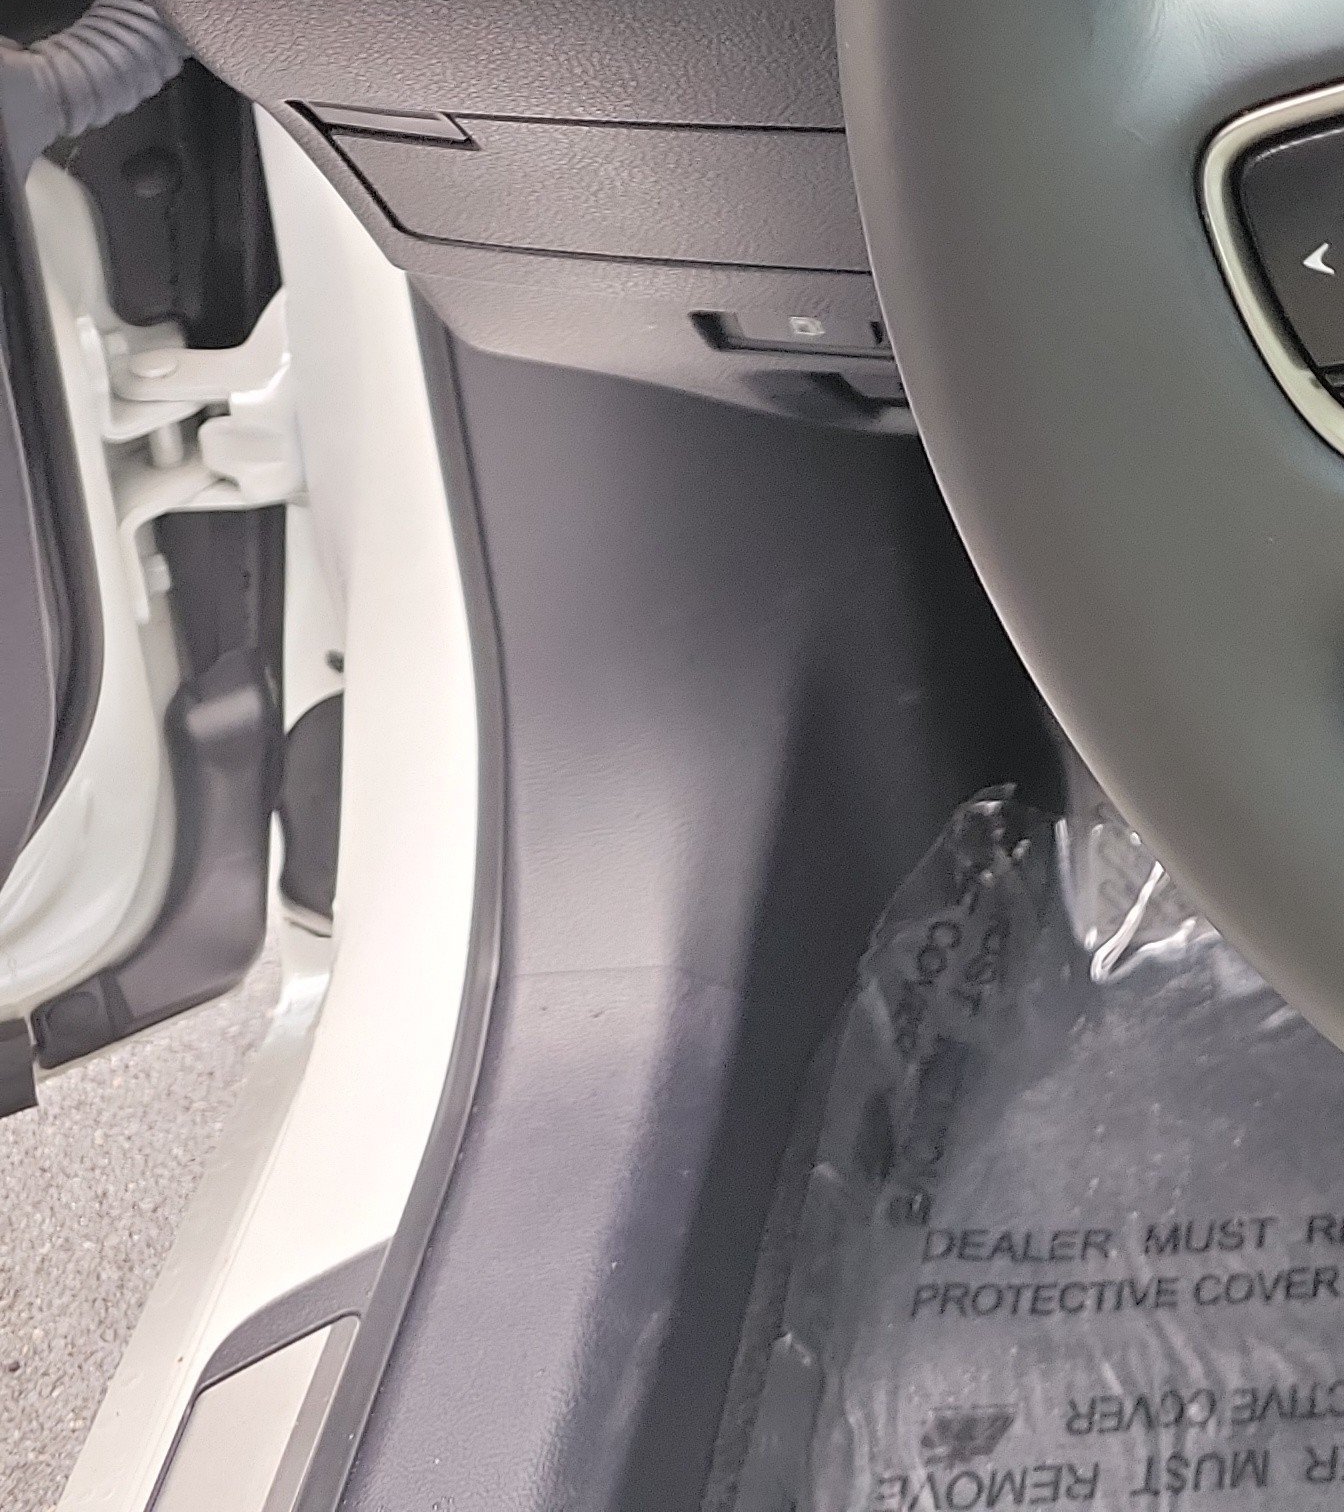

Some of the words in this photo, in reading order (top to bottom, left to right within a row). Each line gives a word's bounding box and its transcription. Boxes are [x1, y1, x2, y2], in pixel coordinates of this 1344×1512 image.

[921, 1226, 1114, 1264] DEALER
[1143, 1215, 1278, 1256] MUST
[909, 1274, 1180, 1321] PROTECTIVE
[1192, 1264, 1343, 1308] COVER
[1064, 1386, 1218, 1437] COVER
[1131, 1445, 1272, 1498] MUST
